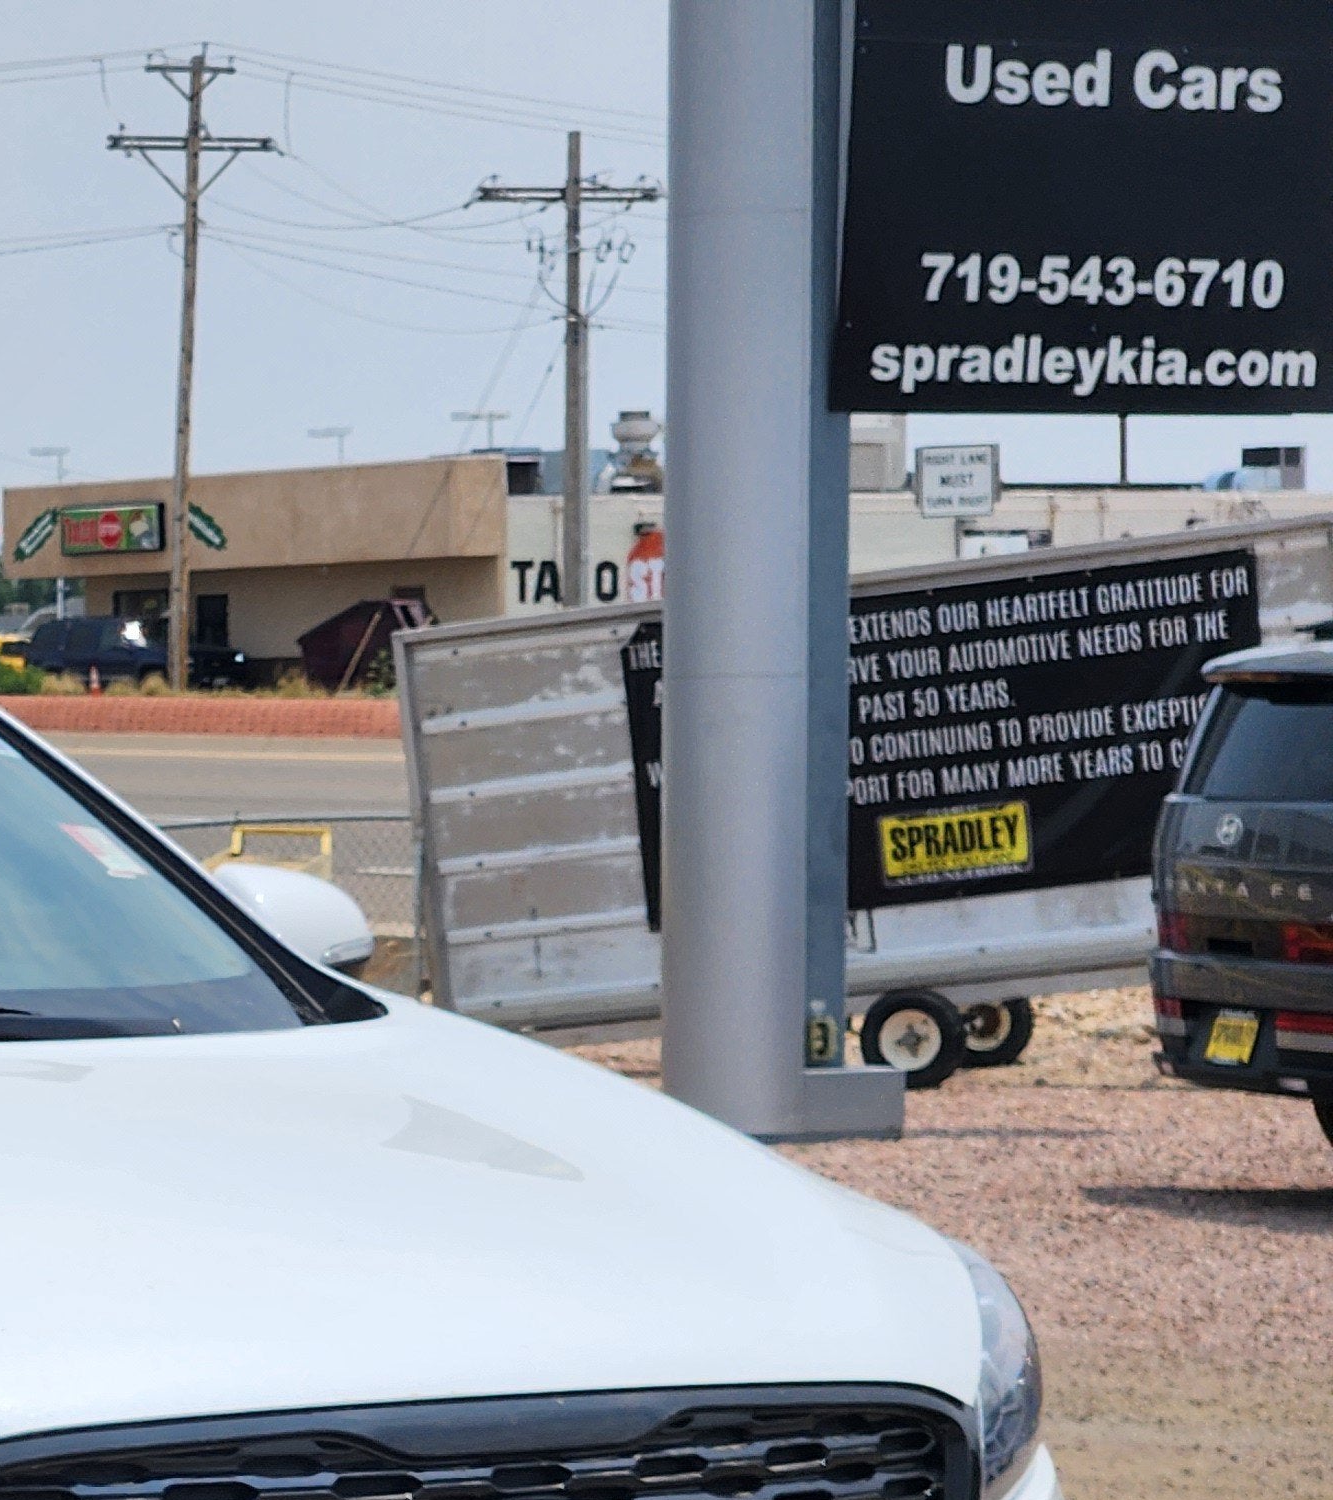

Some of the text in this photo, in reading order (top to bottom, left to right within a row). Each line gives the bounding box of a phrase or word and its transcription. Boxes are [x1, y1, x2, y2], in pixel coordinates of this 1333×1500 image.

[945, 43, 1283, 113] Used Cars
[920, 252, 1285, 309] 719-543-6710
[870, 334, 1317, 396] spradleykia.com
[511, 560, 619, 603] TAO
[849, 606, 931, 645] EXTENDS
[937, 601, 980, 634] OUR
[985, 587, 1090, 629] HEARTFELT
[1096, 572, 1203, 616] GRATITUDE
[1210, 565, 1249, 600] FOR
[886, 646, 942, 680] YOUR
[948, 630, 1073, 674] AUTOMOTIVE
[1077, 621, 1143, 659] NEEDS
[1148, 615, 1189, 649] FOR
[1194, 609, 1229, 643] THE
[858, 678, 1016, 725] PAST 50 YEARS.
[869, 721, 993, 764] CONTINUING
[997, 717, 1023, 748] TO
[1028, 706, 1116, 745] PROVIDE
[896, 768, 935, 801] FOR
[941, 761, 1001, 796] MANY
[1008, 753, 1065, 788] MORE
[1069, 745, 1134, 781] YEARS
[1139, 740, 1164, 773] TO
[889, 815, 1019, 862] SPRADLEY
